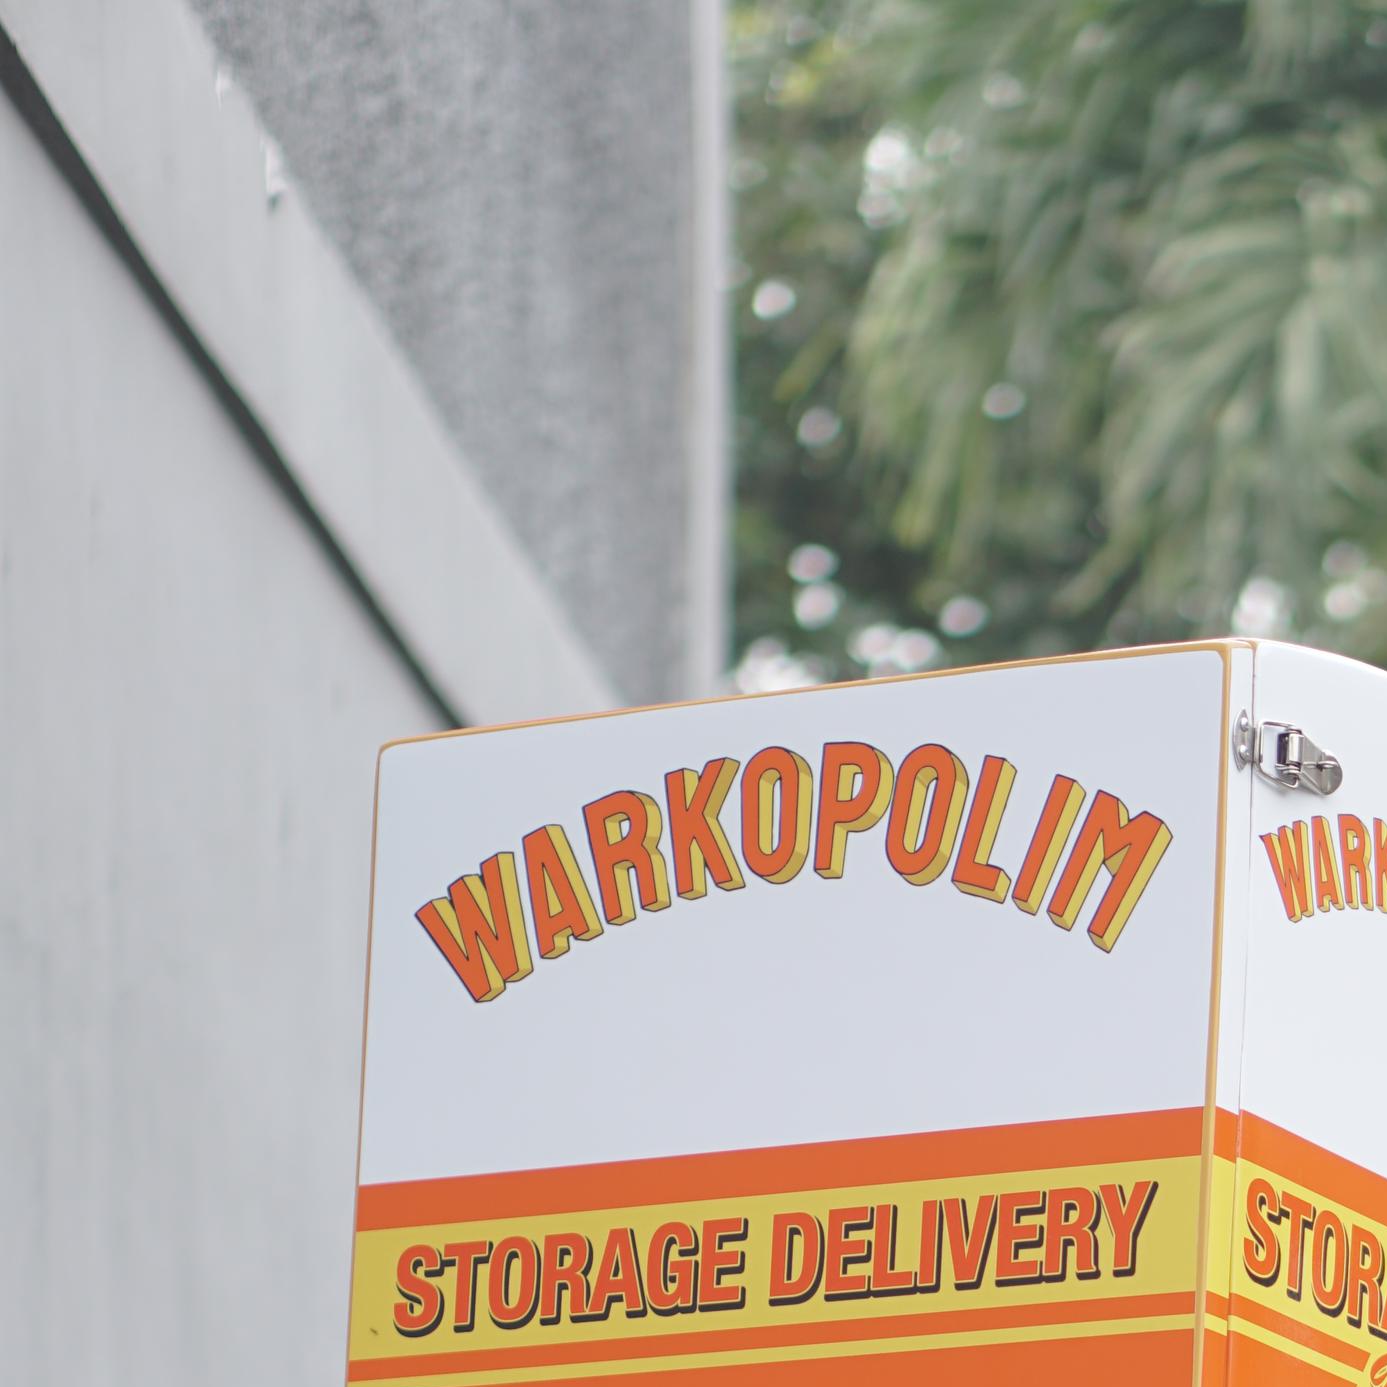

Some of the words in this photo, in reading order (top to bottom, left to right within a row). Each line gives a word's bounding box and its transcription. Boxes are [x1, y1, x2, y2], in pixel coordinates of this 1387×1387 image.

[415, 741, 1173, 1003] WARKOPOLIM
[393, 1217, 748, 1338] STORAGE
[768, 1180, 1159, 1307] DELIVERY
